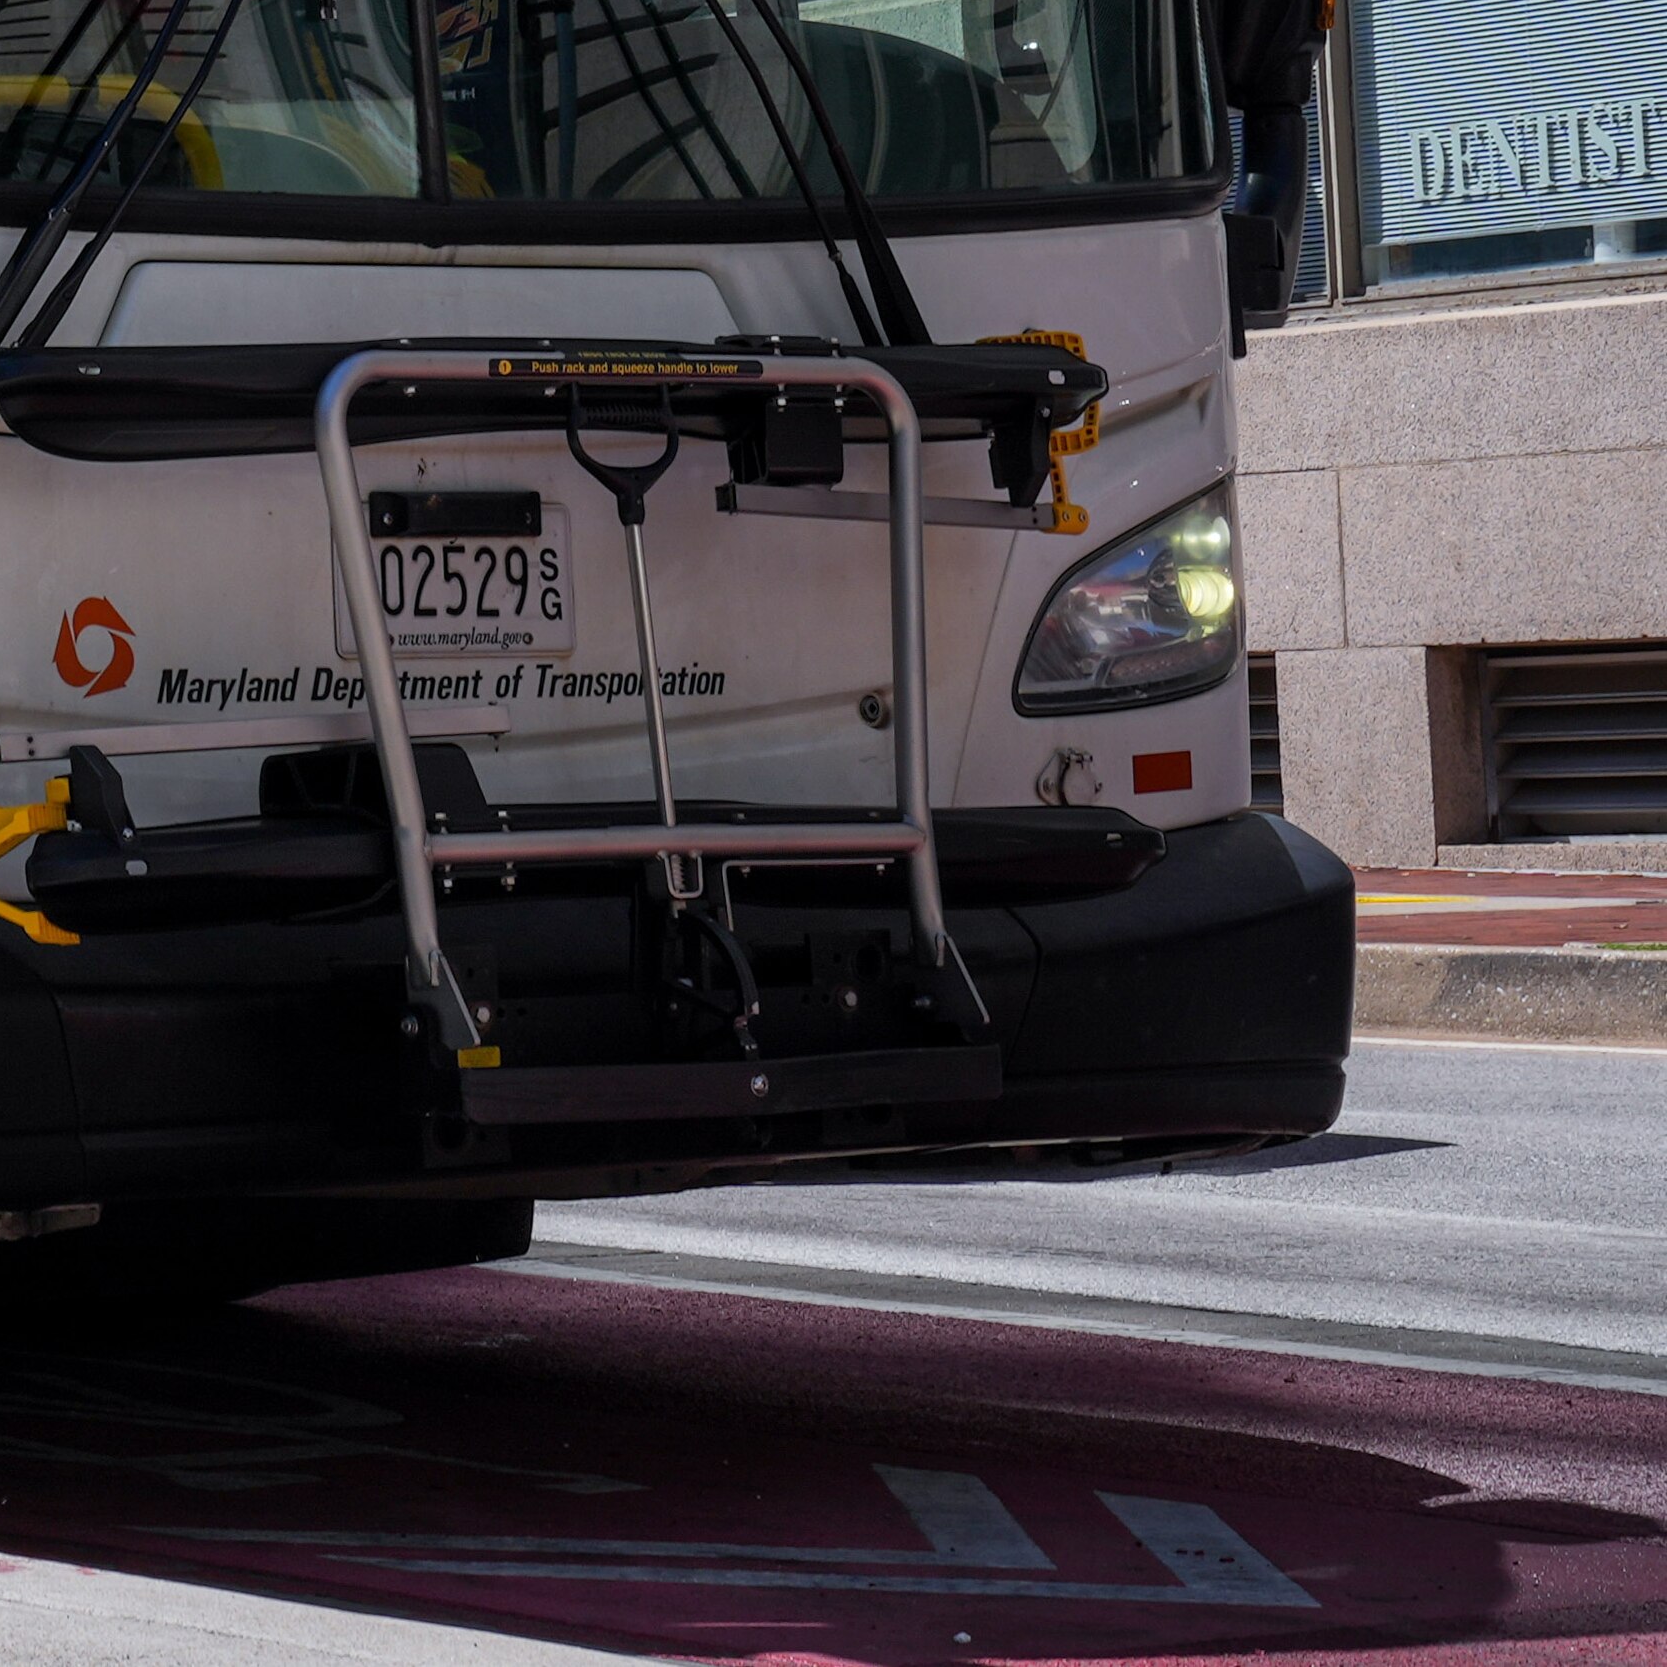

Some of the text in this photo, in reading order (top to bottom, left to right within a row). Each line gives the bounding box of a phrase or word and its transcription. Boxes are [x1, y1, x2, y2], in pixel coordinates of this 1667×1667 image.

[1407, 97, 1656, 201] DENTIST
[532, 360, 559, 374] Push
[562, 361, 585, 374] rack
[588, 361, 608, 374] and
[612, 362, 655, 376] squeeze
[657, 361, 692, 374] handle
[695, 362, 707, 374] to
[709, 361, 740, 374] lower
[378, 543, 564, 622] 02529 S G
[397, 626, 523, 649] www.maryland.gov
[157, 661, 725, 711] Maryland Deptment of Transporation
